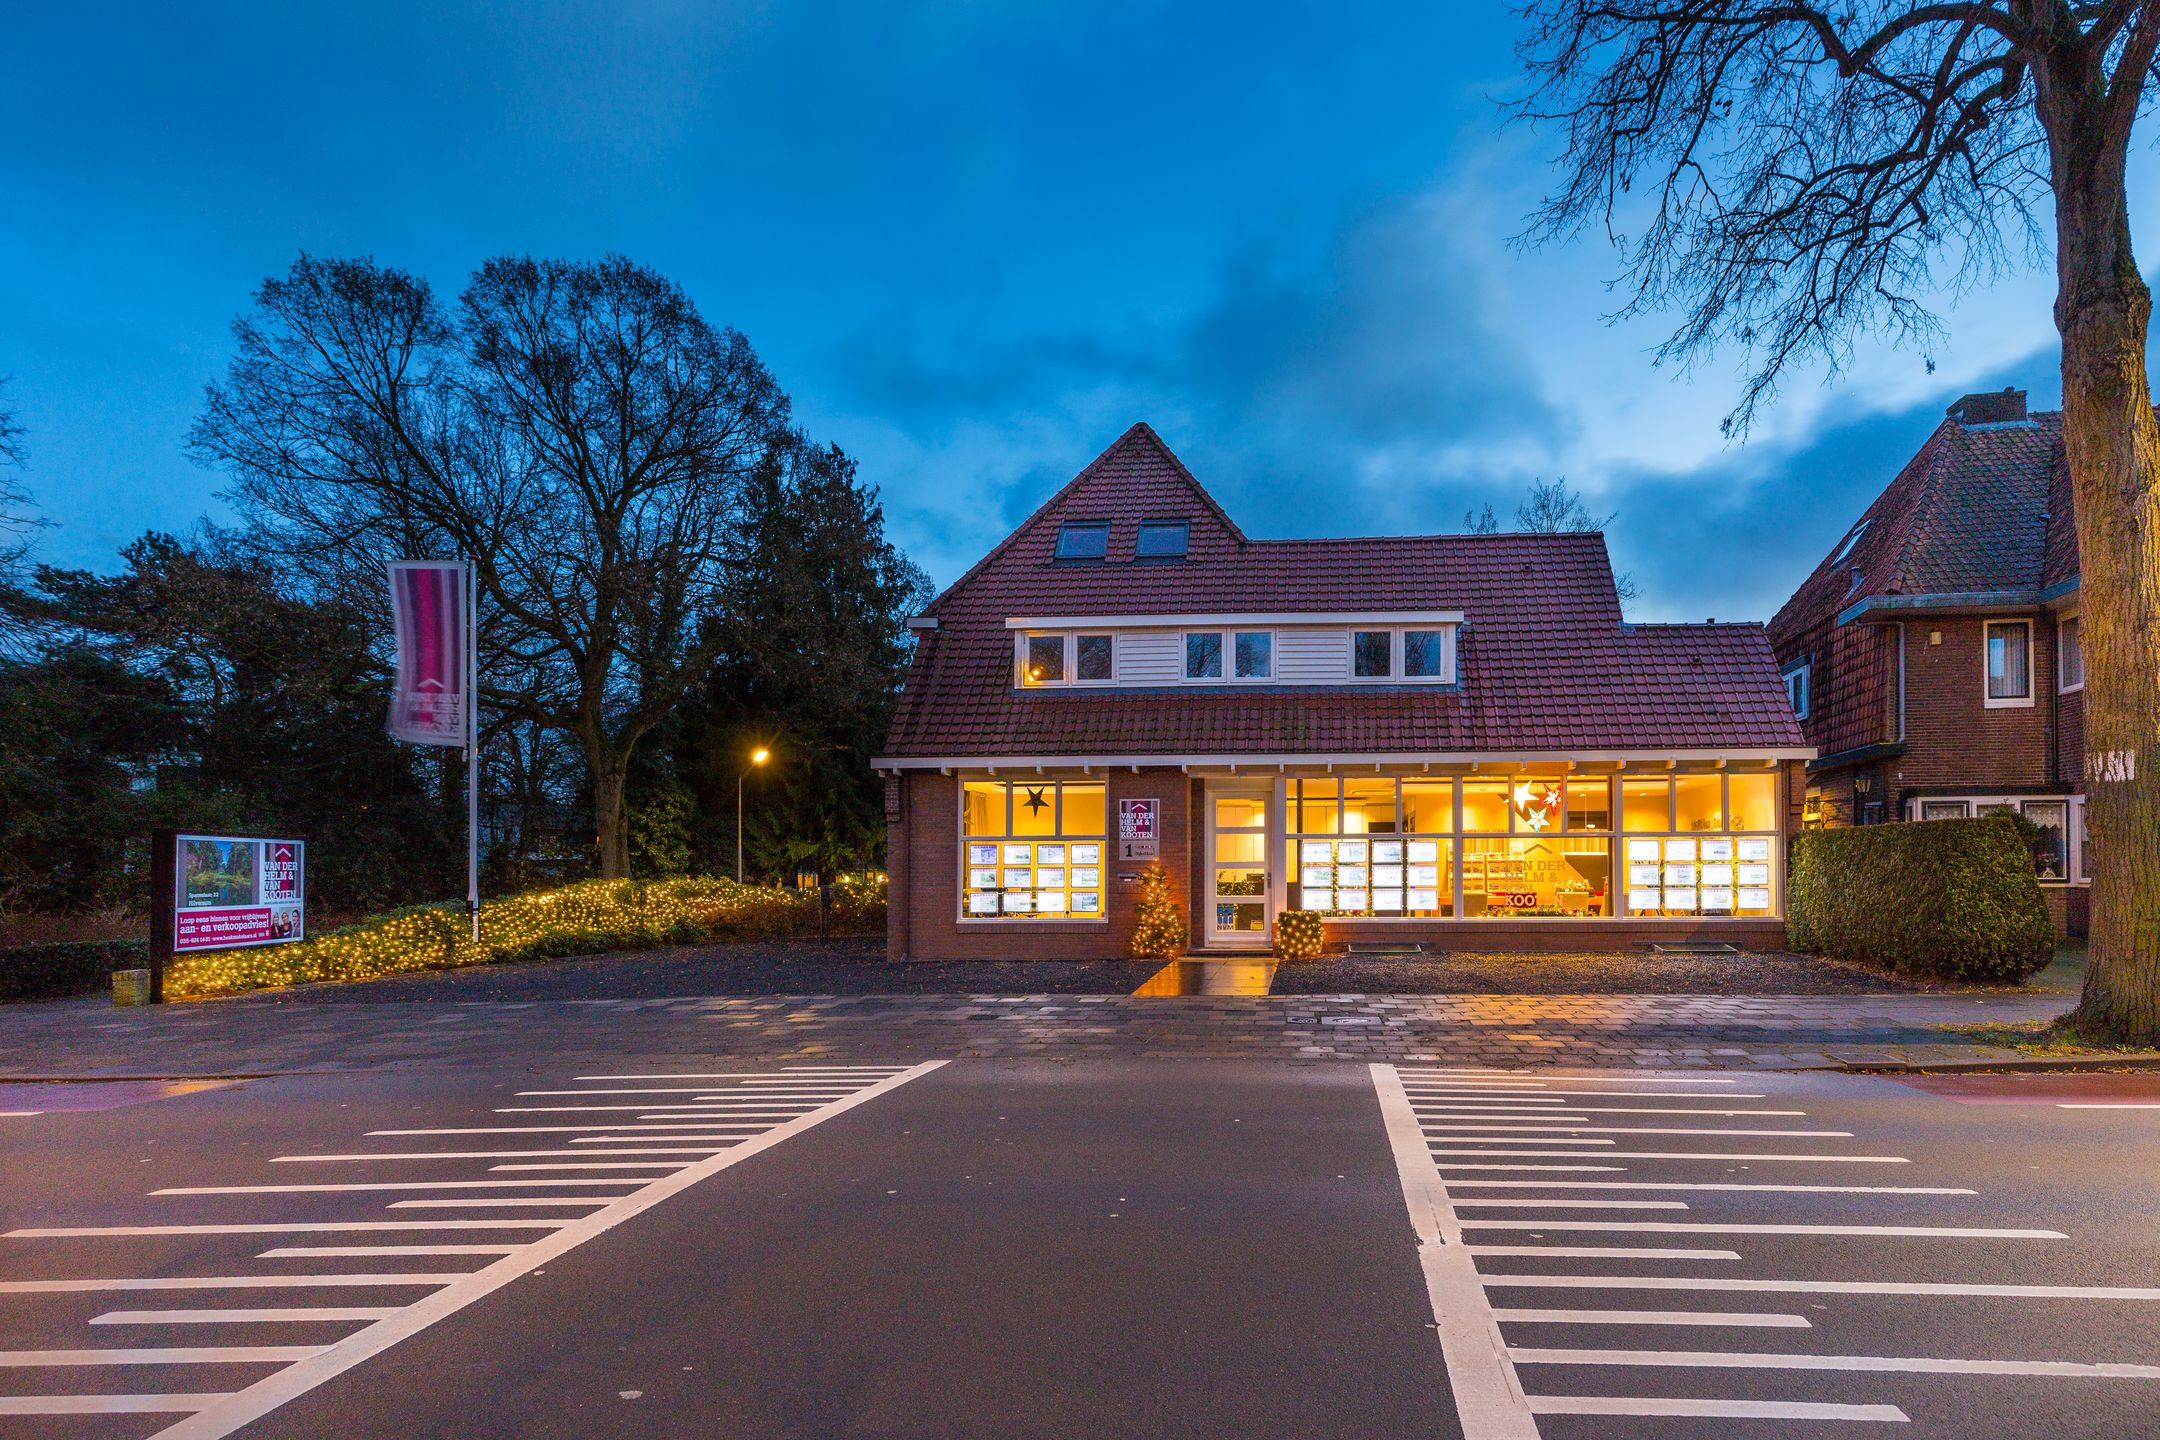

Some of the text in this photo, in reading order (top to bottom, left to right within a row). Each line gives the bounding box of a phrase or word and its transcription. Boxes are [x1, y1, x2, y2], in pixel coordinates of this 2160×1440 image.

[1125, 844, 1132, 857] 1
[264, 861, 298, 870] VAN DER
[1537, 861, 1566, 870] DER
[265, 871, 294, 880] HELM &
[1549, 872, 1556, 882] &
[264, 881, 280, 890] VAN
[264, 890, 296, 899] KOOTEN
[180, 919, 269, 934] aan- en verkoopadvies!
